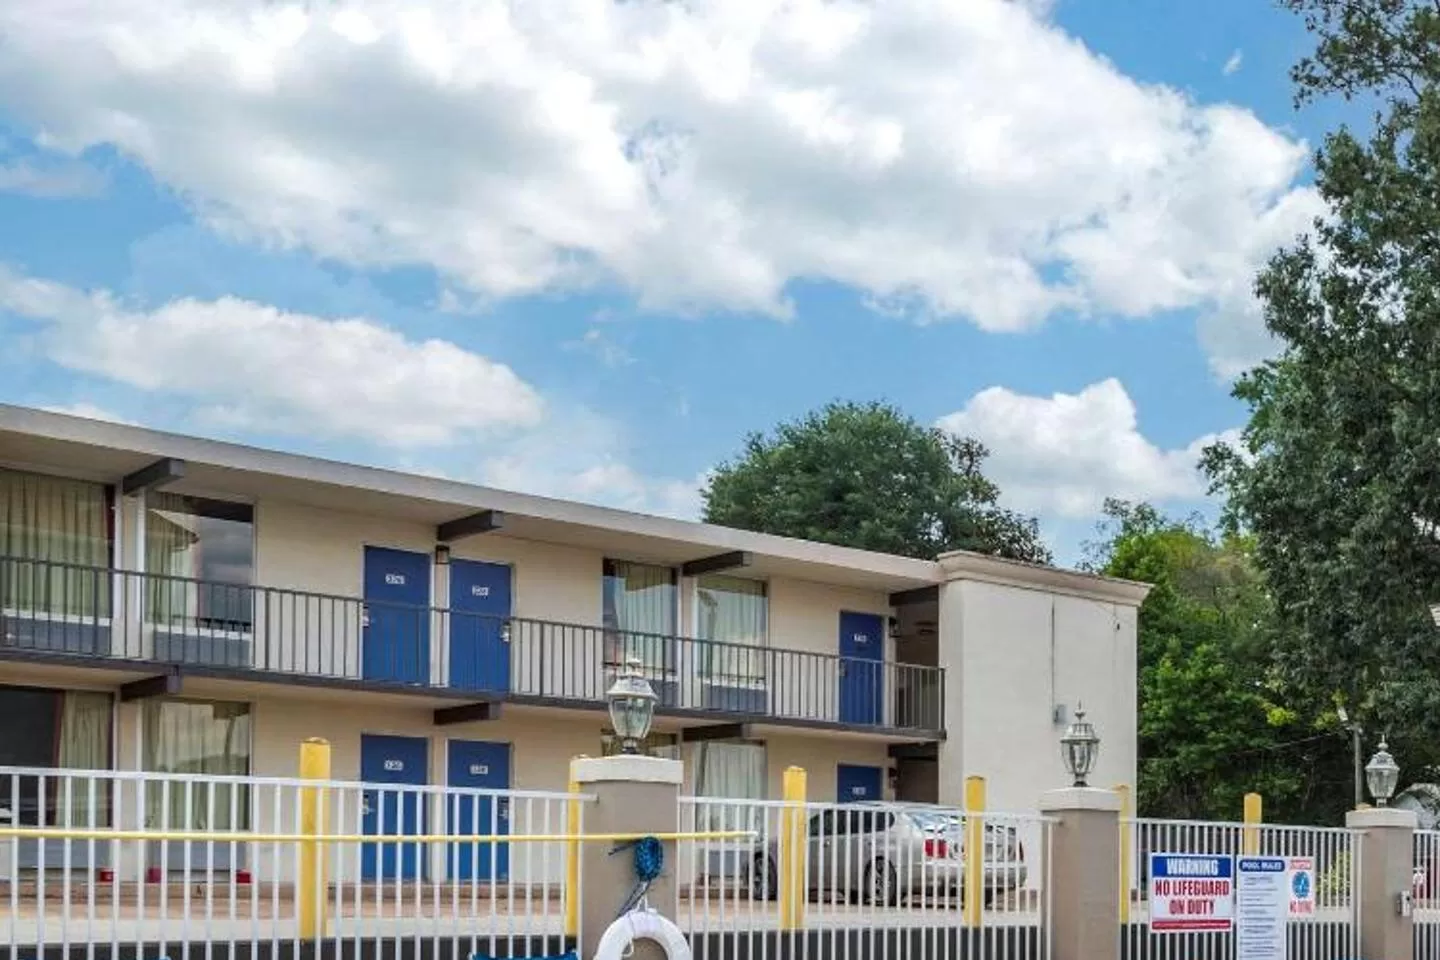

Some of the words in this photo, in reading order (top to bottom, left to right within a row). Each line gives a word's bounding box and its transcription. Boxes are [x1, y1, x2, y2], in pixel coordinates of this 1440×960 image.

[1167, 858, 1218, 876] WARNING
[1155, 880, 1170, 896] NO
[1173, 880, 1230, 896] LIFEGUARD
[1169, 900, 1184, 915] ON
[1187, 900, 1214, 914] DUTY
